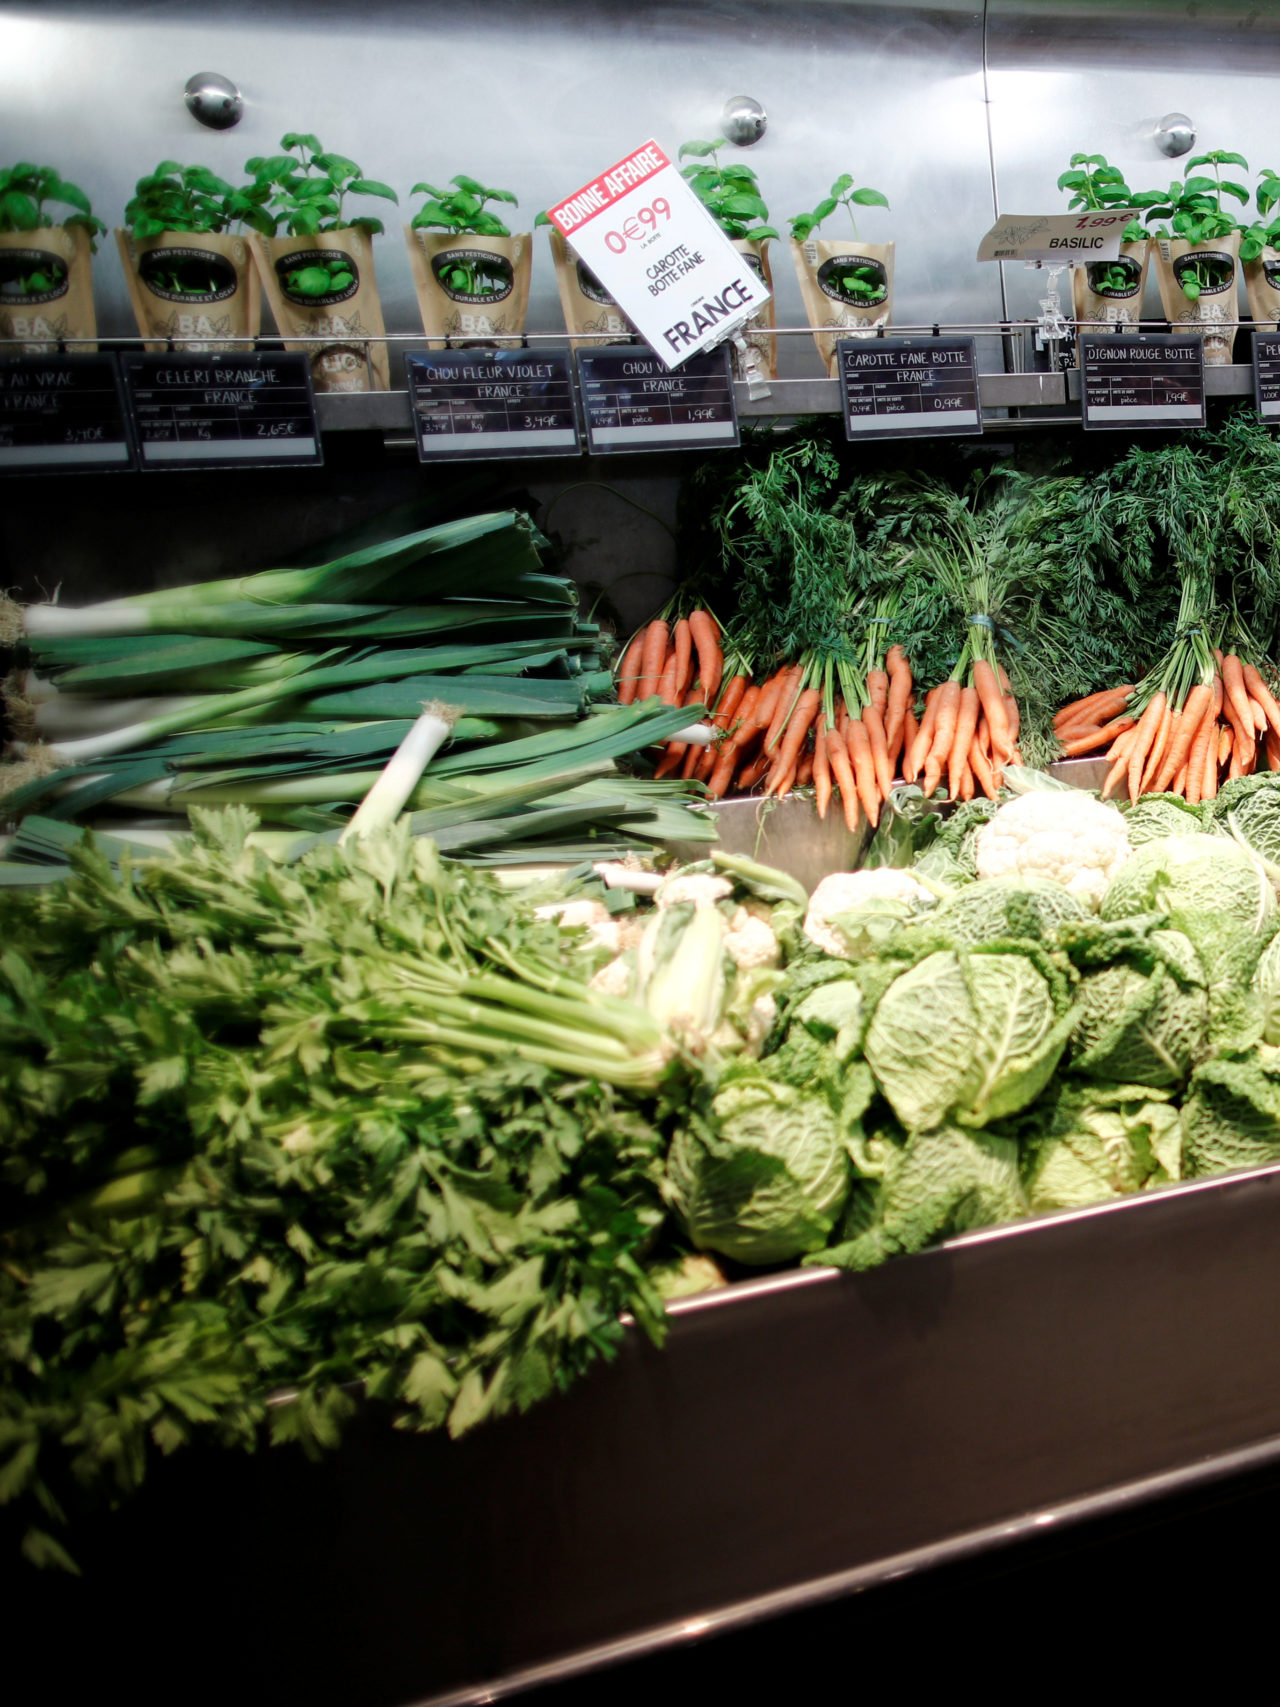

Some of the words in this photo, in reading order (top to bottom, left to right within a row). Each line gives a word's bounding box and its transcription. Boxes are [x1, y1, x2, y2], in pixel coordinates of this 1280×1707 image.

[554, 184, 609, 231] BONNE
[602, 146, 664, 202] AFFAIRE
[604, 197, 671, 254] 0€99
[1075, 212, 1134, 230] 1,99€
[1049, 237, 1104, 249] BASILIC
[152, 249, 171, 259] SANS
[172, 249, 217, 261] PESTICIDES
[284, 254, 301, 264] SANS
[446, 251, 464, 259] SANS
[465, 251, 501, 263] PESTICIDES
[645, 244, 690, 280] CAROTTE
[833, 257, 848, 265] SANS
[849, 256, 879, 268] PESTICIDES
[1183, 254, 1198, 262] SANS
[648, 266, 682, 297] BOTTE
[675, 251, 705, 279] FANE
[662, 279, 753, 353] FRANCE
[1106, 308, 1130, 322] BA
[1200, 305, 1223, 318] BA
[12, 317, 51, 337] BA
[178, 315, 212, 333] BA
[318, 316, 347, 335] BA
[460, 314, 492, 333] BA
[848, 353, 897, 367] CAROTTE
[900, 353, 929, 365] FANE
[932, 351, 967, 363] BOTTE
[1088, 348, 1127, 360] OIGNON
[1129, 348, 1162, 359] ROUGE
[1164, 348, 1196, 359] BOTTE
[426, 367, 459, 380] CHOU
[463, 366, 504, 380] FLEUR
[506, 364, 554, 379] VIOLET
[623, 362, 653, 374] CHOU
[35, 370, 76, 387] VRAC
[156, 369, 210, 384] CELERI
[215, 368, 281, 384] BRANCHE
[896, 370, 936, 382] FRANCE
[477, 385, 525, 398] FRANCE
[643, 379, 687, 392] FRANCE
[204, 390, 258, 404] FRANCE
[934, 397, 963, 409] 0,99€
[1165, 392, 1188, 403] 1,99€
[687, 408, 716, 421] 1,99€
[197, 427, 212, 440] Kg
[256, 422, 297, 436] 2,65€
[471, 421, 483, 432] Kg
